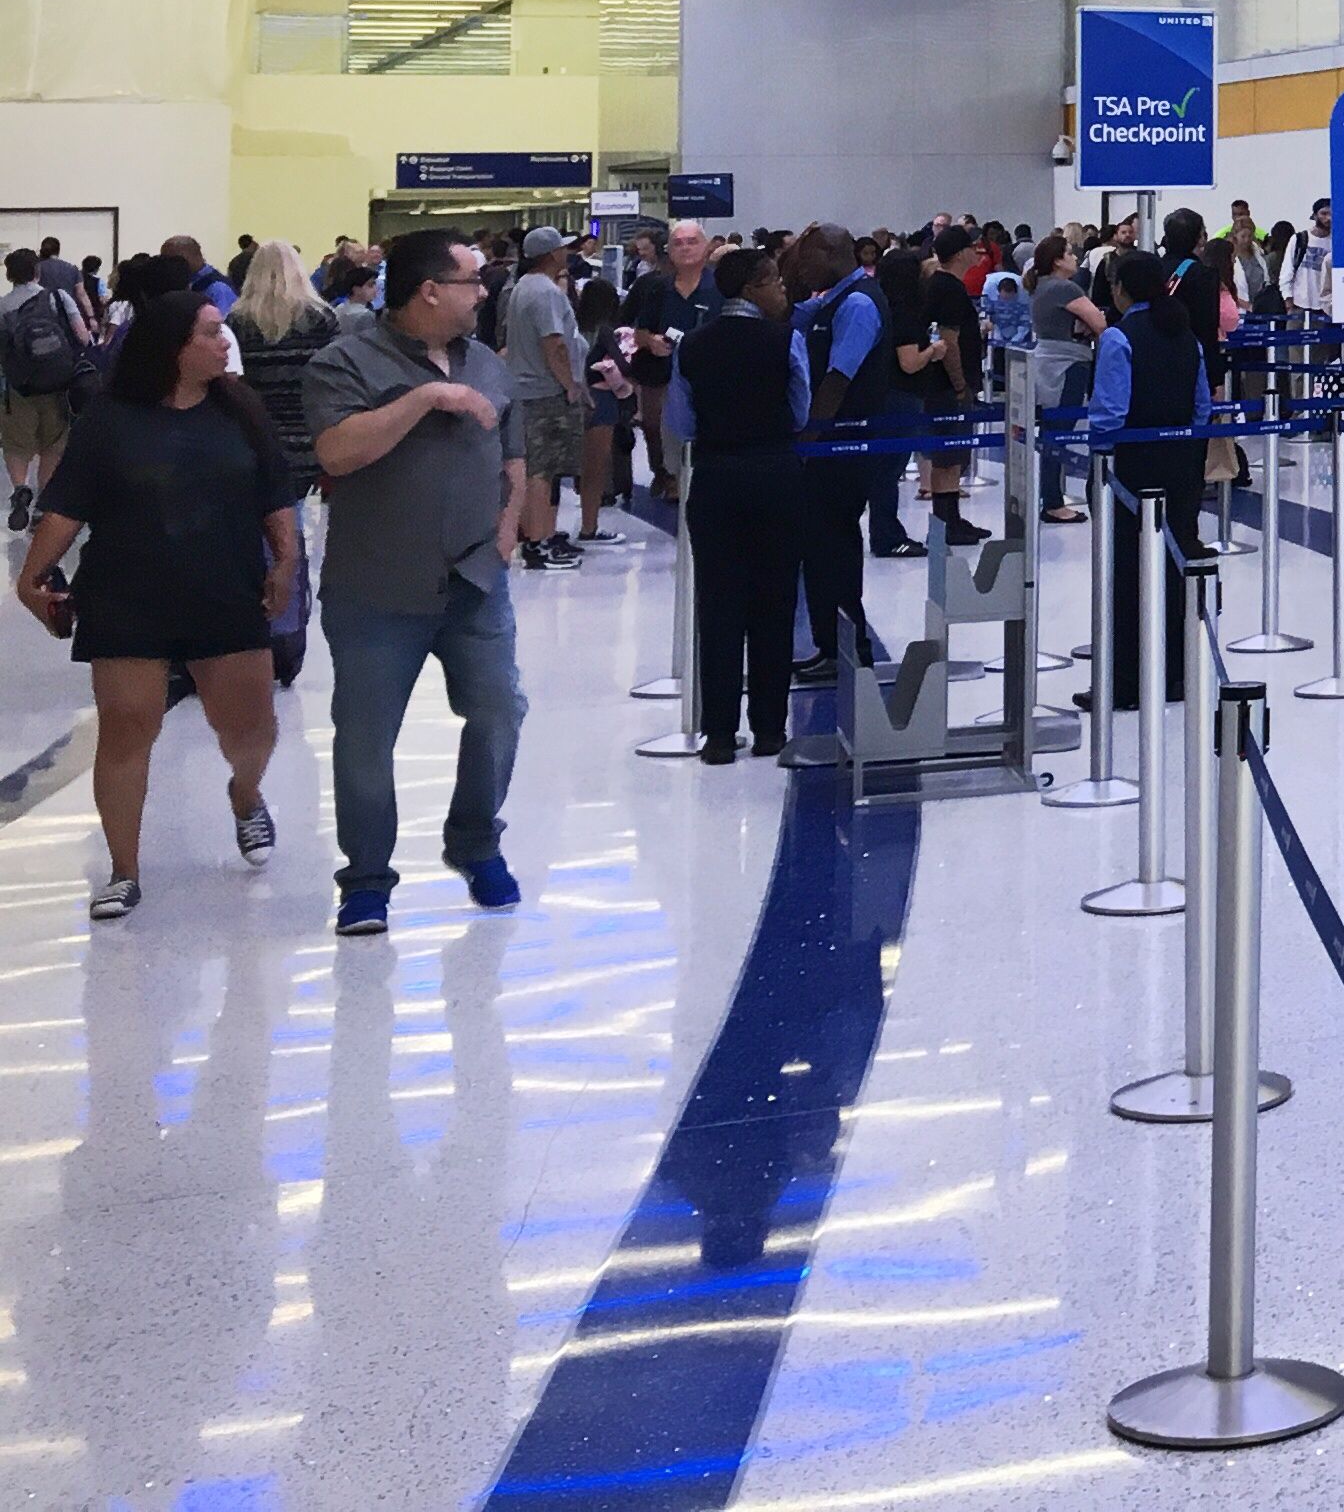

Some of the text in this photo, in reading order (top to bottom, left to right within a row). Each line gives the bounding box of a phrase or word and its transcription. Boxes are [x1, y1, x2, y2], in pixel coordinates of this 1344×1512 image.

[1158, 17, 1201, 25] UNITED
[1093, 96, 1171, 116] TSA Pre
[1089, 123, 1207, 145] Checkpoint
[594, 202, 635, 211] Economy
